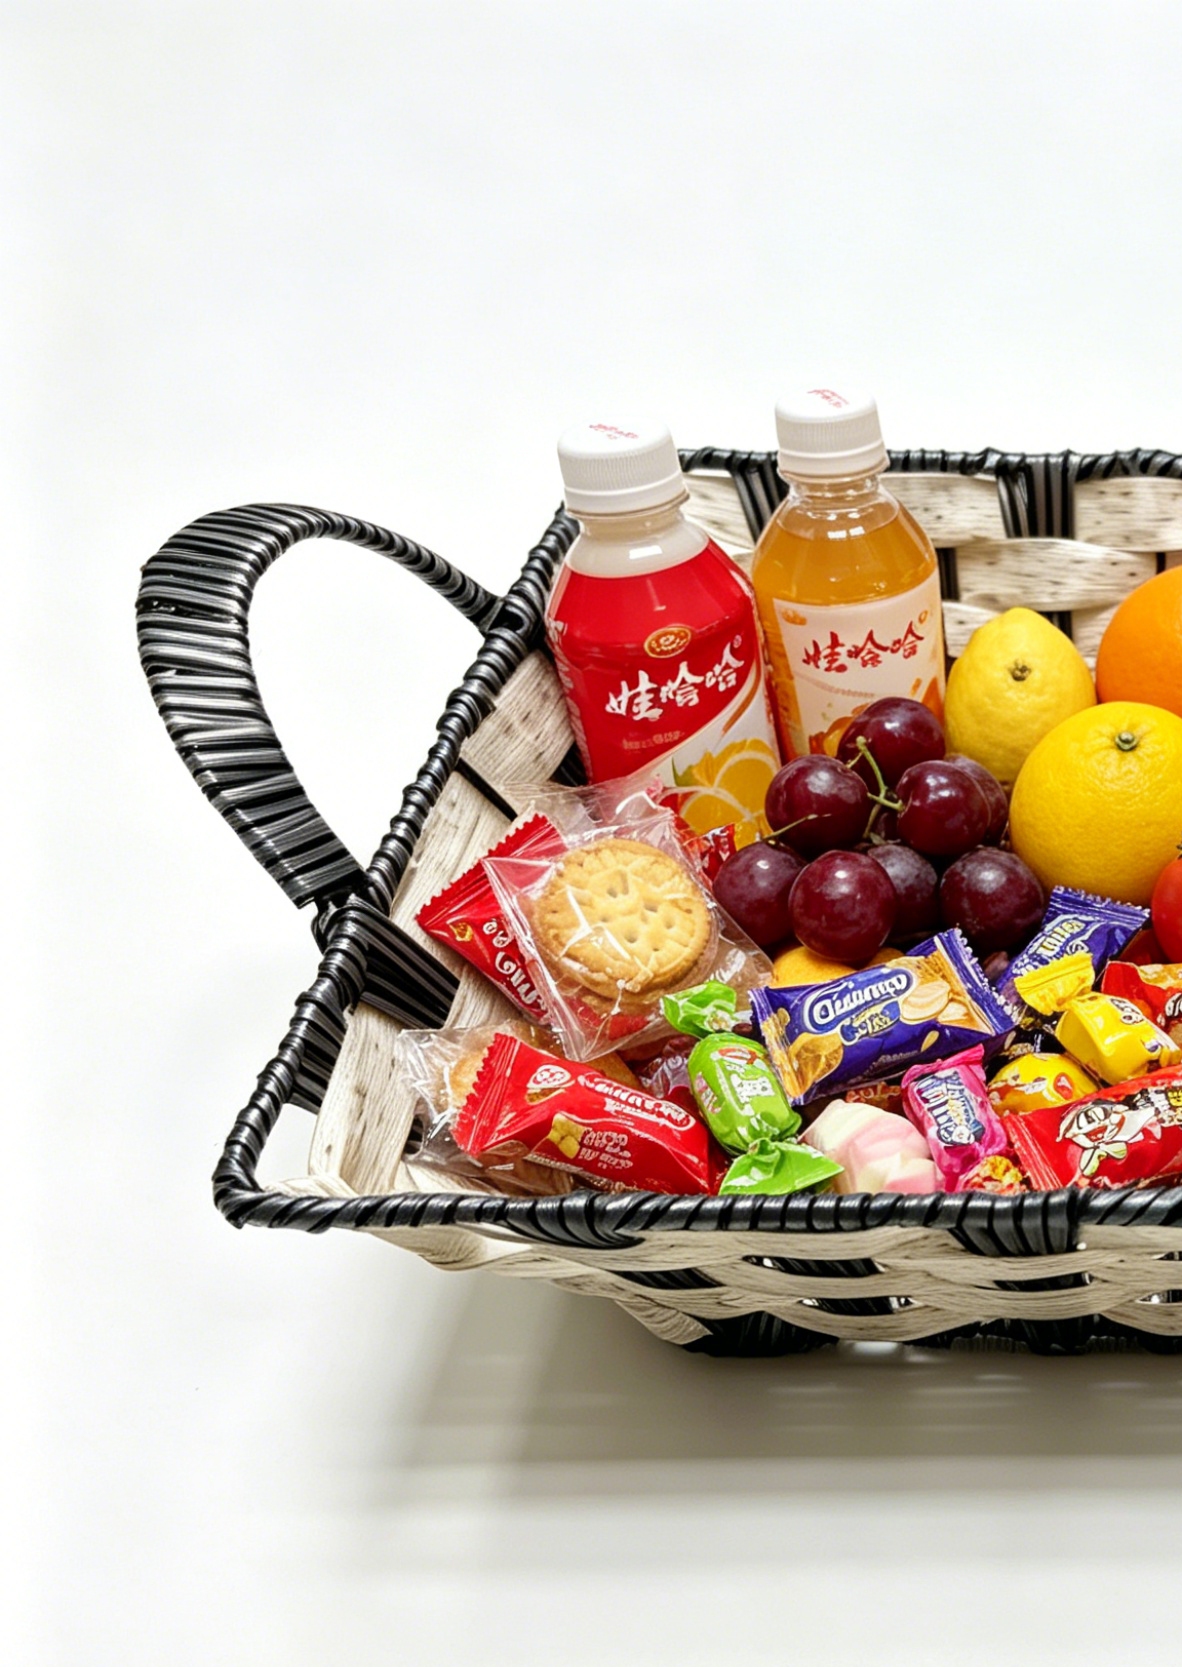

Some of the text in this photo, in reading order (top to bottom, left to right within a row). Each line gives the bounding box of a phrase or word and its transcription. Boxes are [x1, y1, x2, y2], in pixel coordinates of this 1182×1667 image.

[802, 620, 925, 673] 娃哈哈
[605, 642, 745, 721] 娃哈哈
